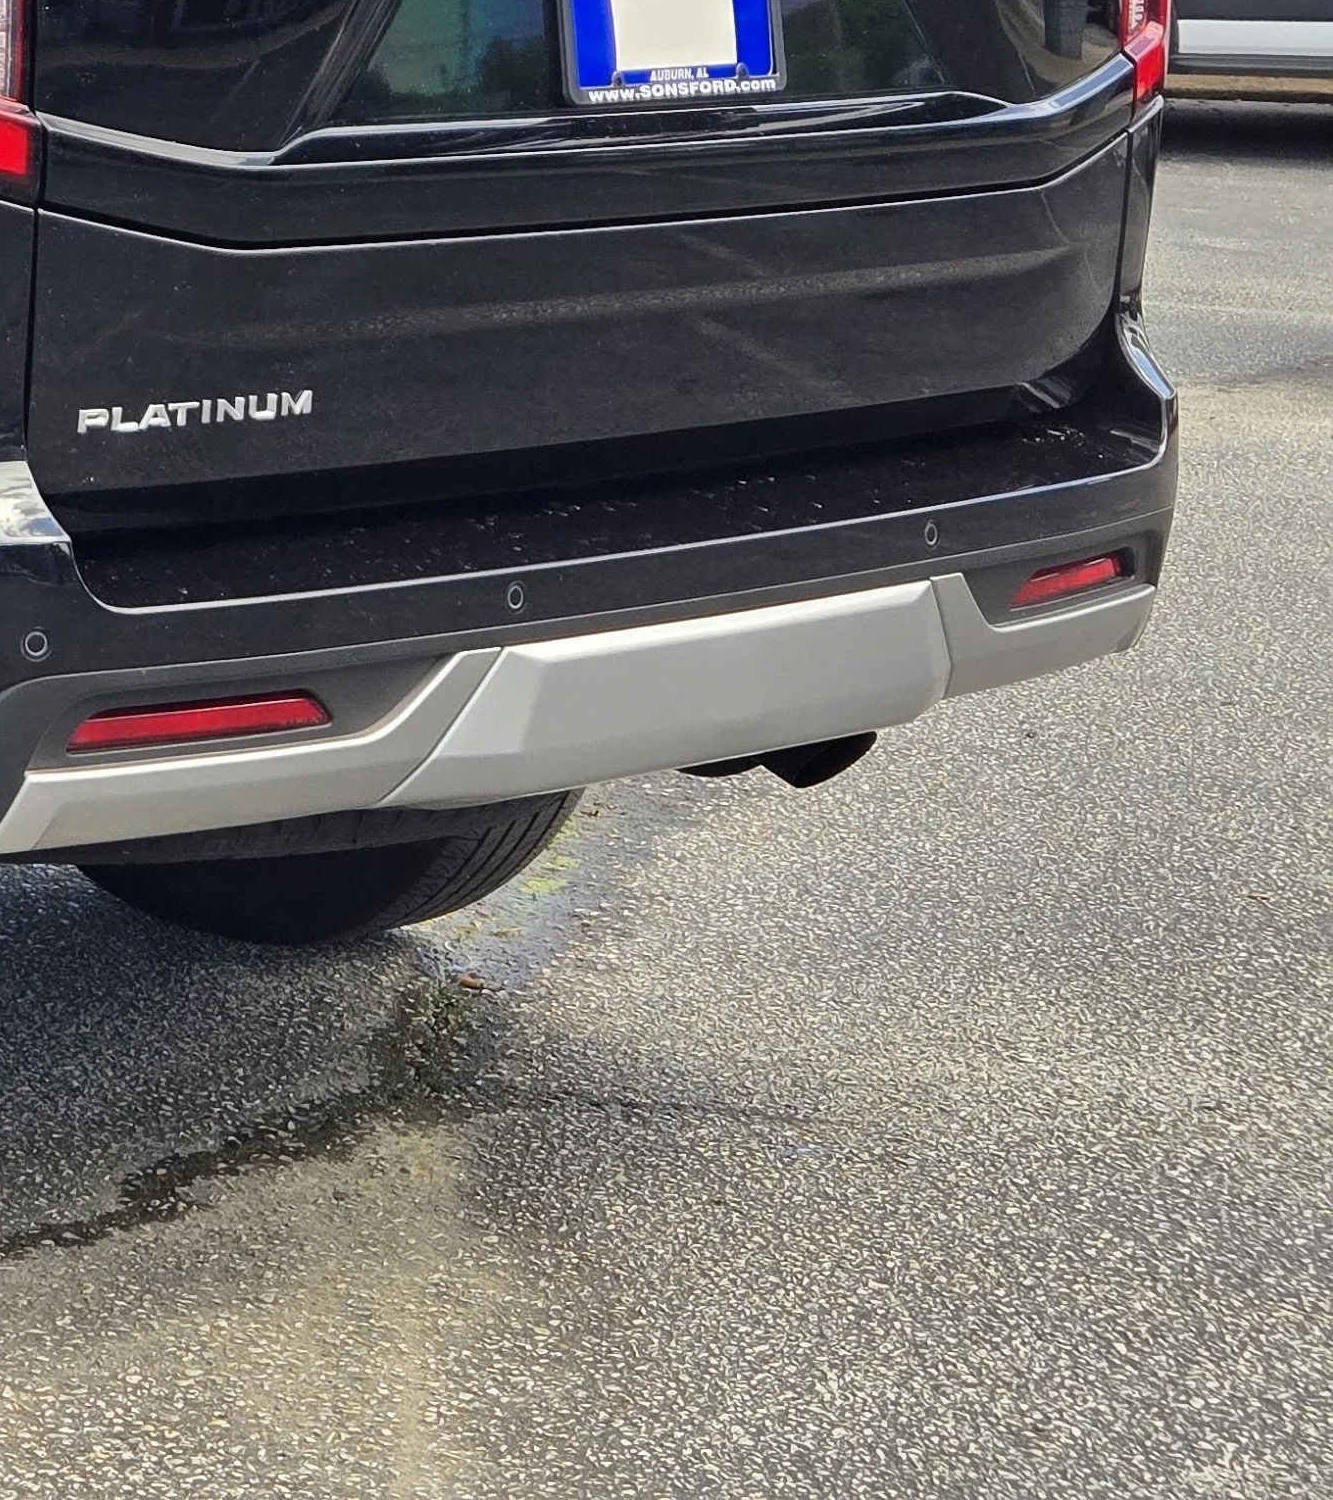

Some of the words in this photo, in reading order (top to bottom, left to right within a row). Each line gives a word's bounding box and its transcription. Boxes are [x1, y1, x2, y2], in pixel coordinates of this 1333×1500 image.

[649, 68, 694, 82] AUBURN,
[696, 66, 709, 79] AL
[588, 77, 776, 104] www.SONSFORD.com
[76, 389, 314, 434] PLATINUM
